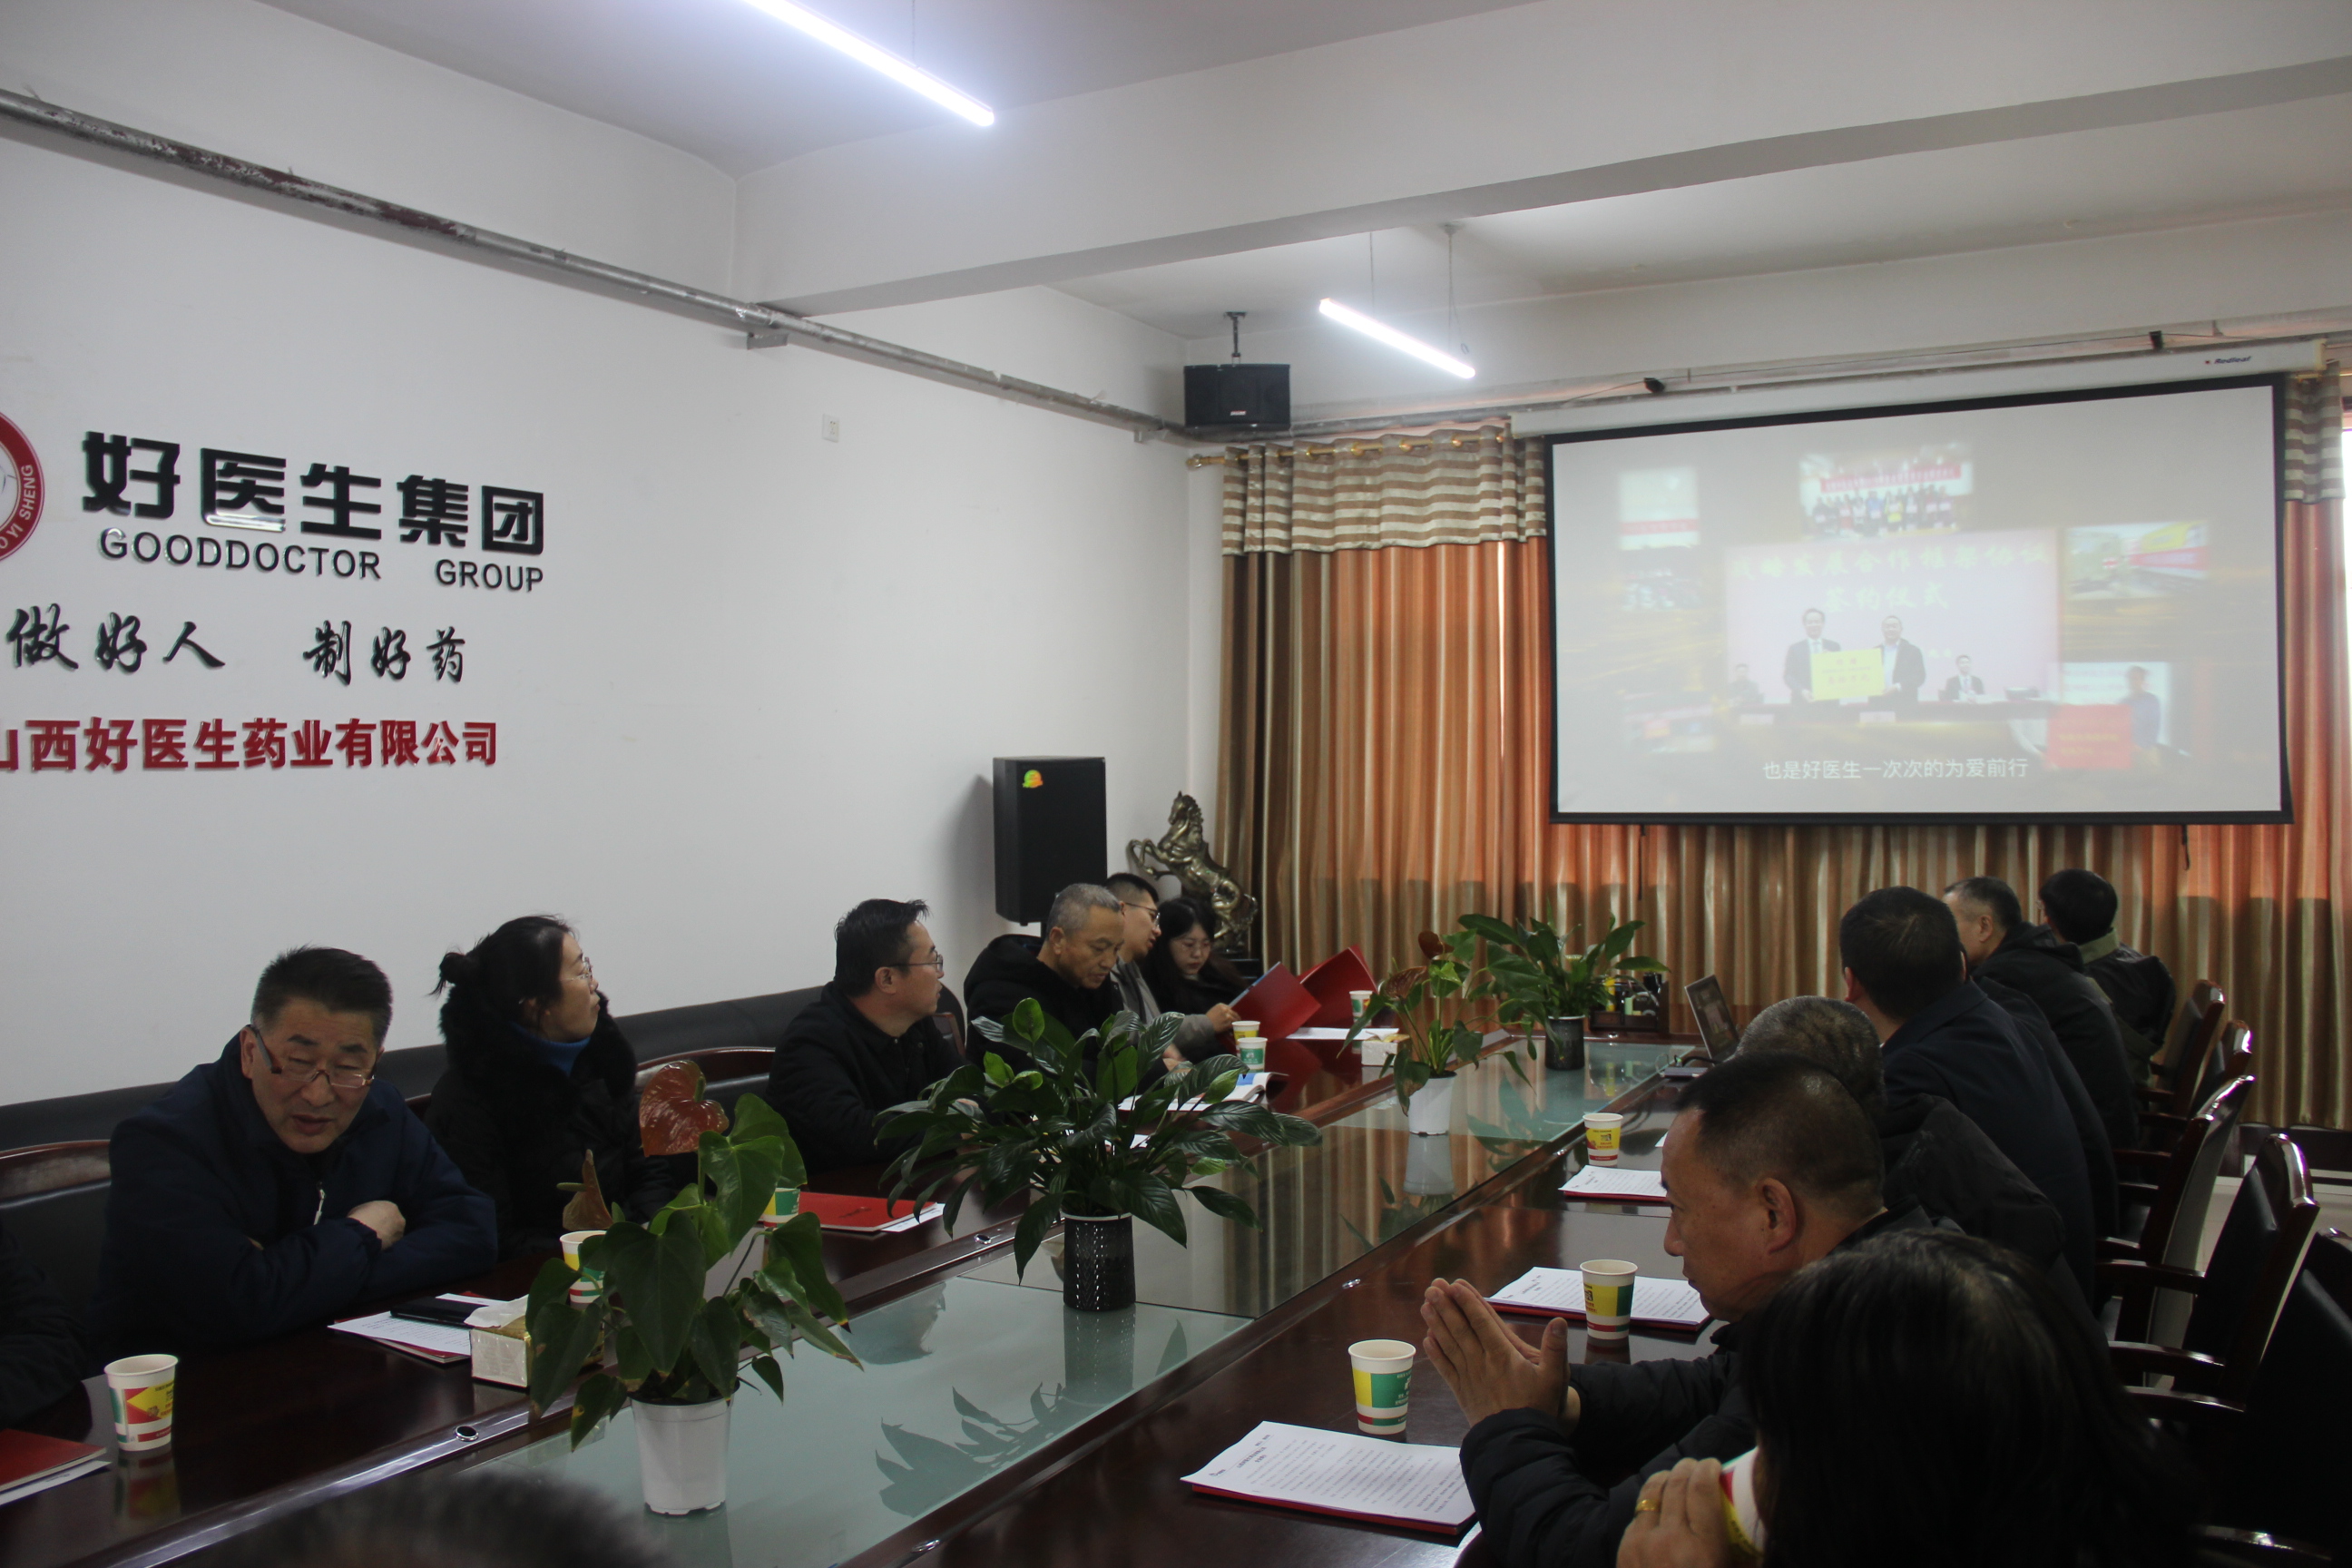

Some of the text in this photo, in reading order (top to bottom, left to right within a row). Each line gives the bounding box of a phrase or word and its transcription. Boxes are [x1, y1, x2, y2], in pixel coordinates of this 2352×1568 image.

[20, 464, 36, 520] SHENG
[82, 431, 544, 555] 好医生集团
[99, 527, 544, 593] GOODDOCTOR GROUP
[6, 603, 466, 686] 做好人 制好药
[1762, 757, 2029, 780] 也是好医生一次次的为爱前行
